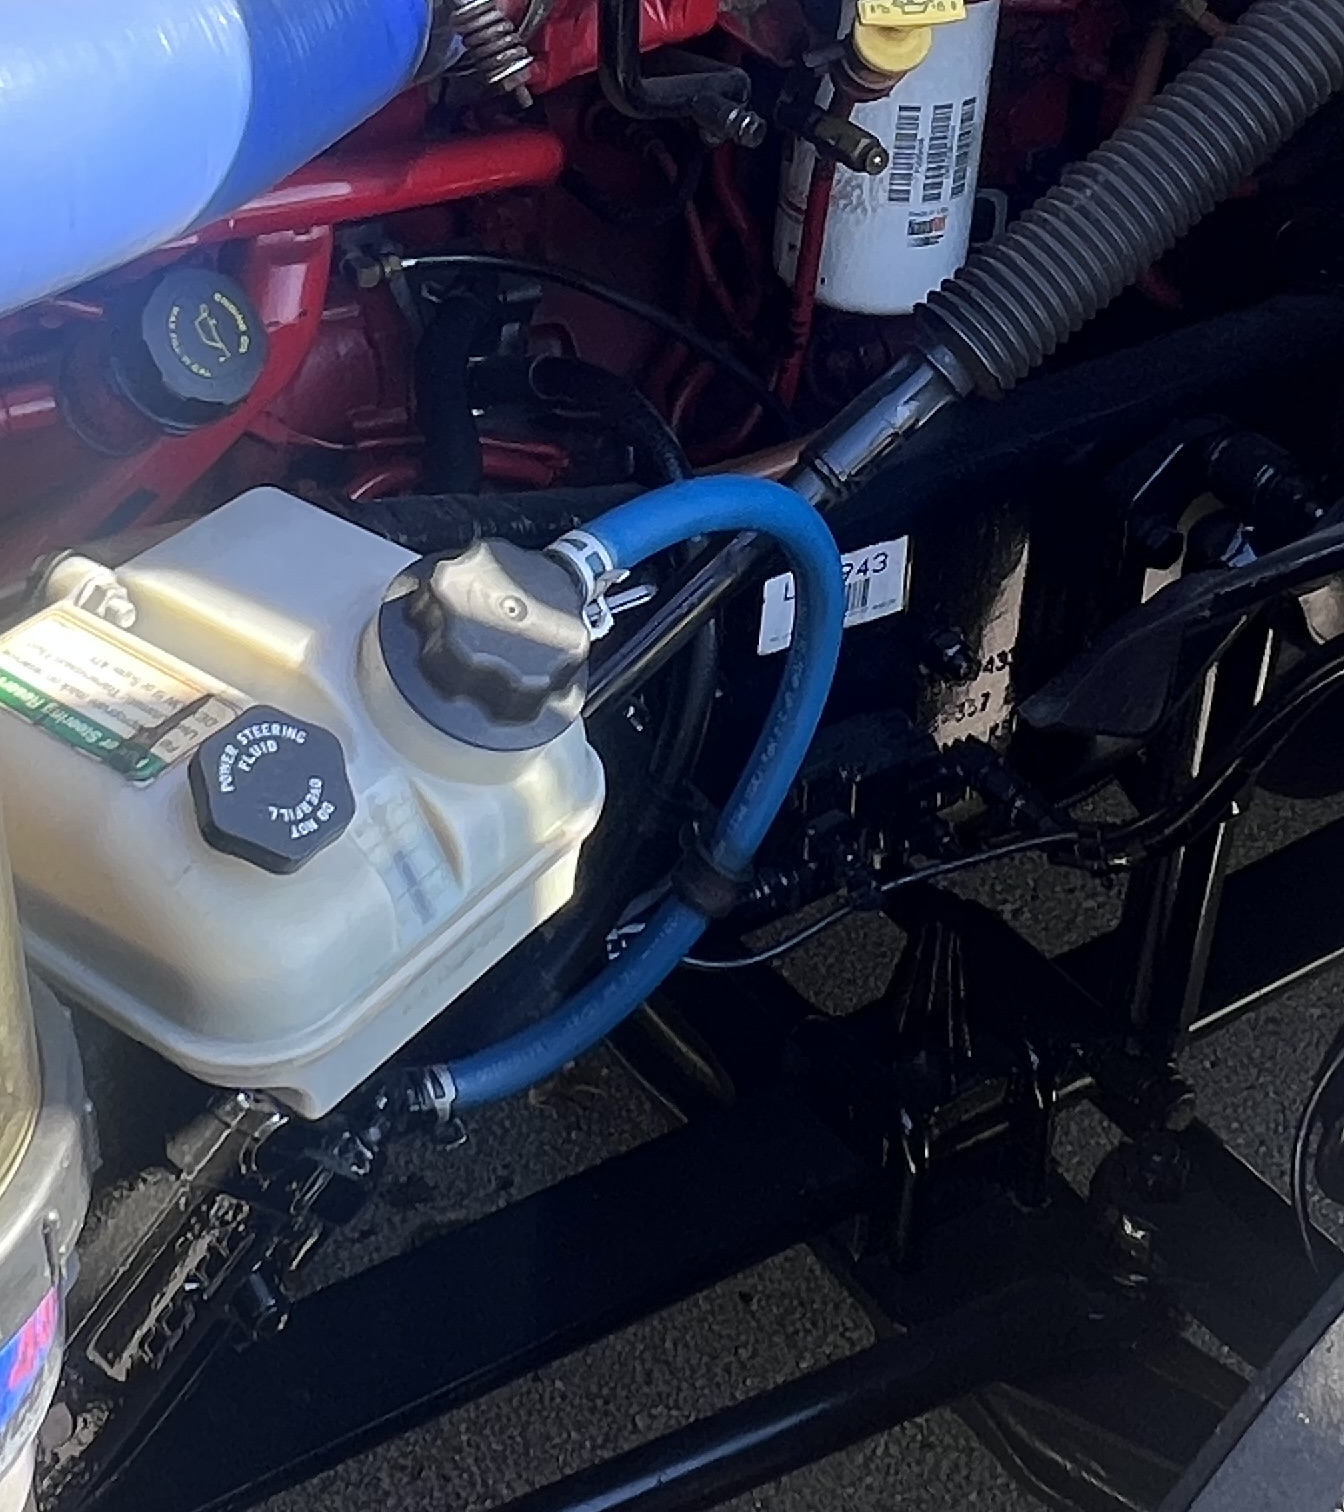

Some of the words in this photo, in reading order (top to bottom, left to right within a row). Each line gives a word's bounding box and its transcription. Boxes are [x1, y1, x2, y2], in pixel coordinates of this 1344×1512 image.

[218, 743, 240, 793] POWER
[236, 722, 307, 746] STEERING
[237, 739, 279, 773] FLUID
[316, 800, 336, 822] DO
[289, 817, 320, 839] NOT
